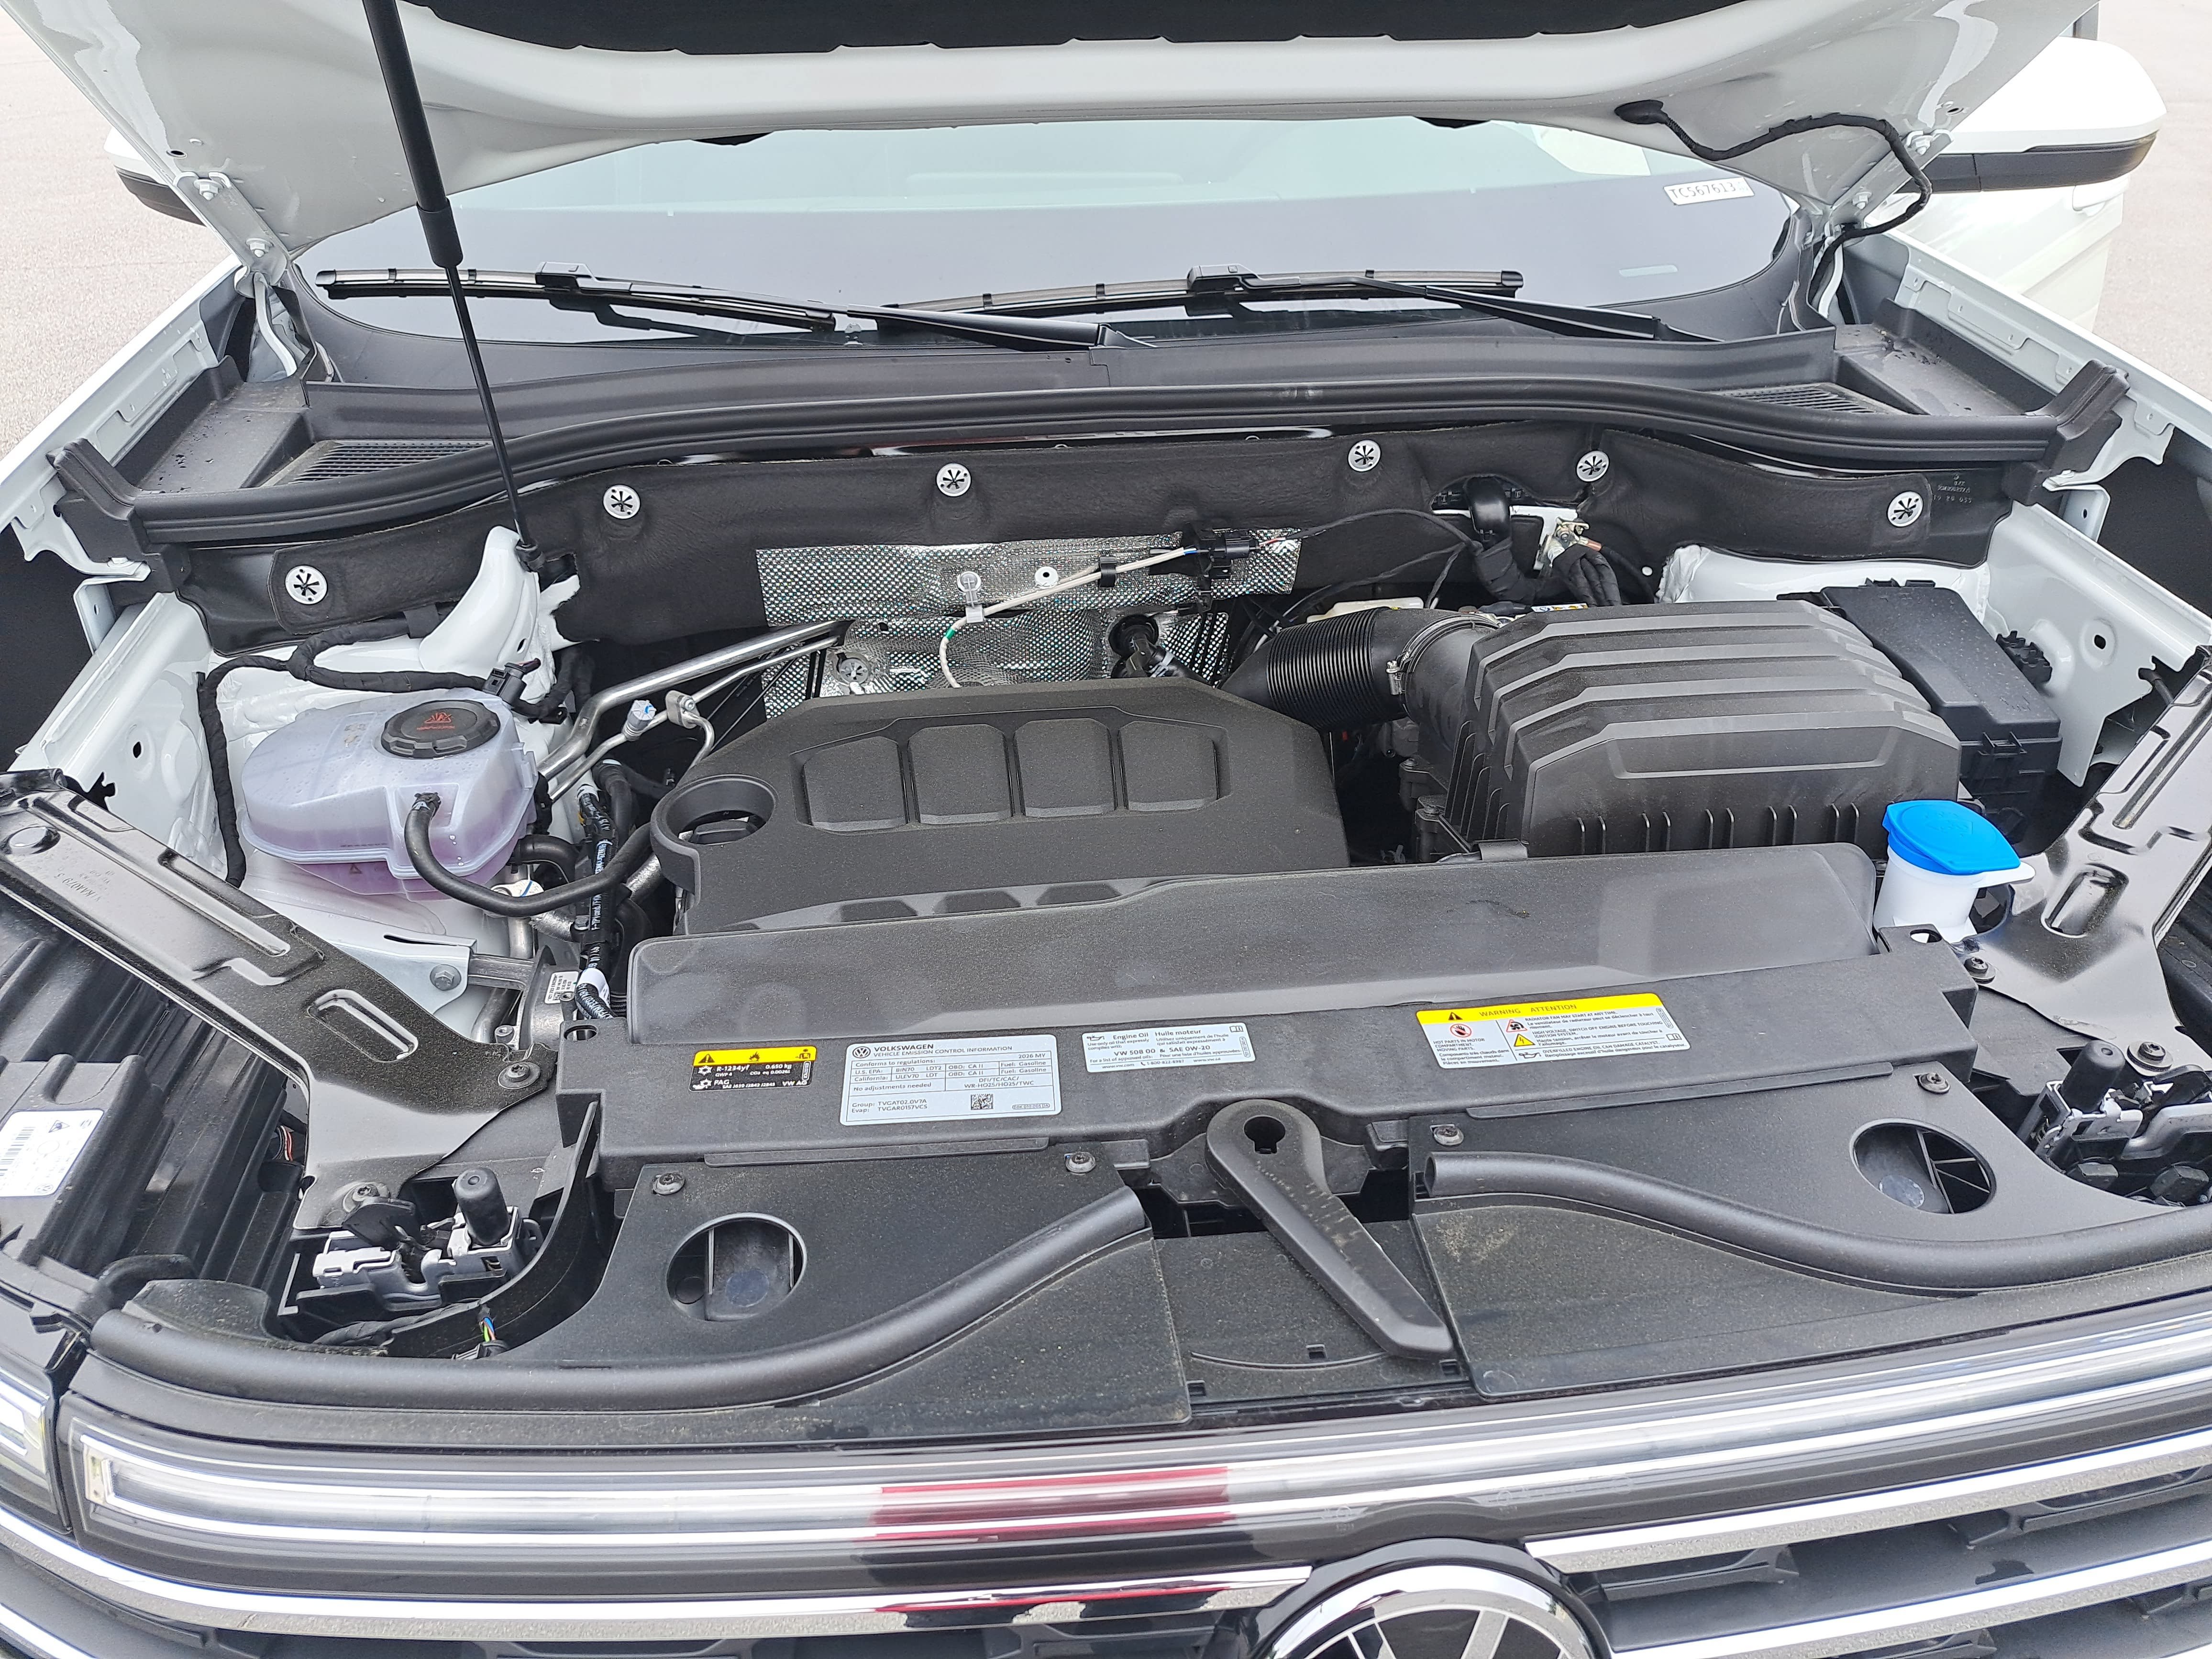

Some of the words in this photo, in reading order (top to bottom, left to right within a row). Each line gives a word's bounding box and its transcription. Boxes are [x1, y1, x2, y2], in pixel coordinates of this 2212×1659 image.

[1669, 182, 1736, 199] TC567613
[1479, 1008, 1521, 1017] WARNING
[1531, 1004, 1577, 1013] ATTENTION
[864, 1084, 906, 1092] adjustments
